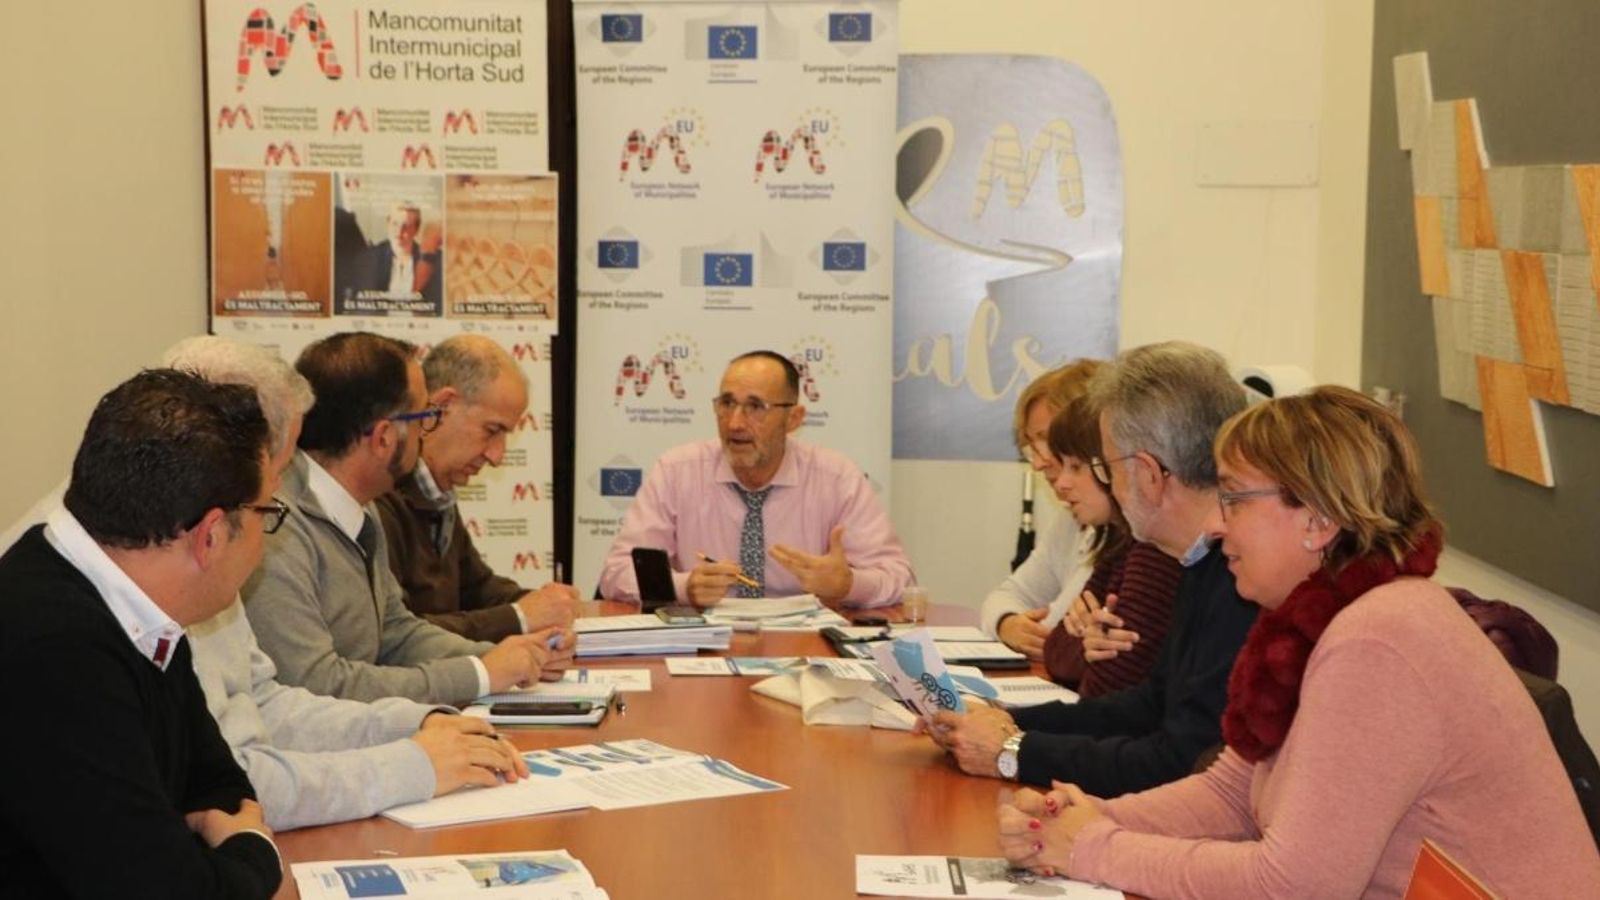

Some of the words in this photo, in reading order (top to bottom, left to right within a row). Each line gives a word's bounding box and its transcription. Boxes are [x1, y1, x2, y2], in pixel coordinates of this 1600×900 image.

[368, 10, 523, 33] Mancomunitat
[369, 34, 522, 61] Intermunicipal
[369, 61, 397, 80] de
[403, 61, 475, 81] l'Horta
[481, 62, 525, 83] Sud
[676, 119, 694, 133] EU
[811, 119, 830, 133] EU
[671, 345, 689, 359] EU
[805, 348, 823, 362] EU
